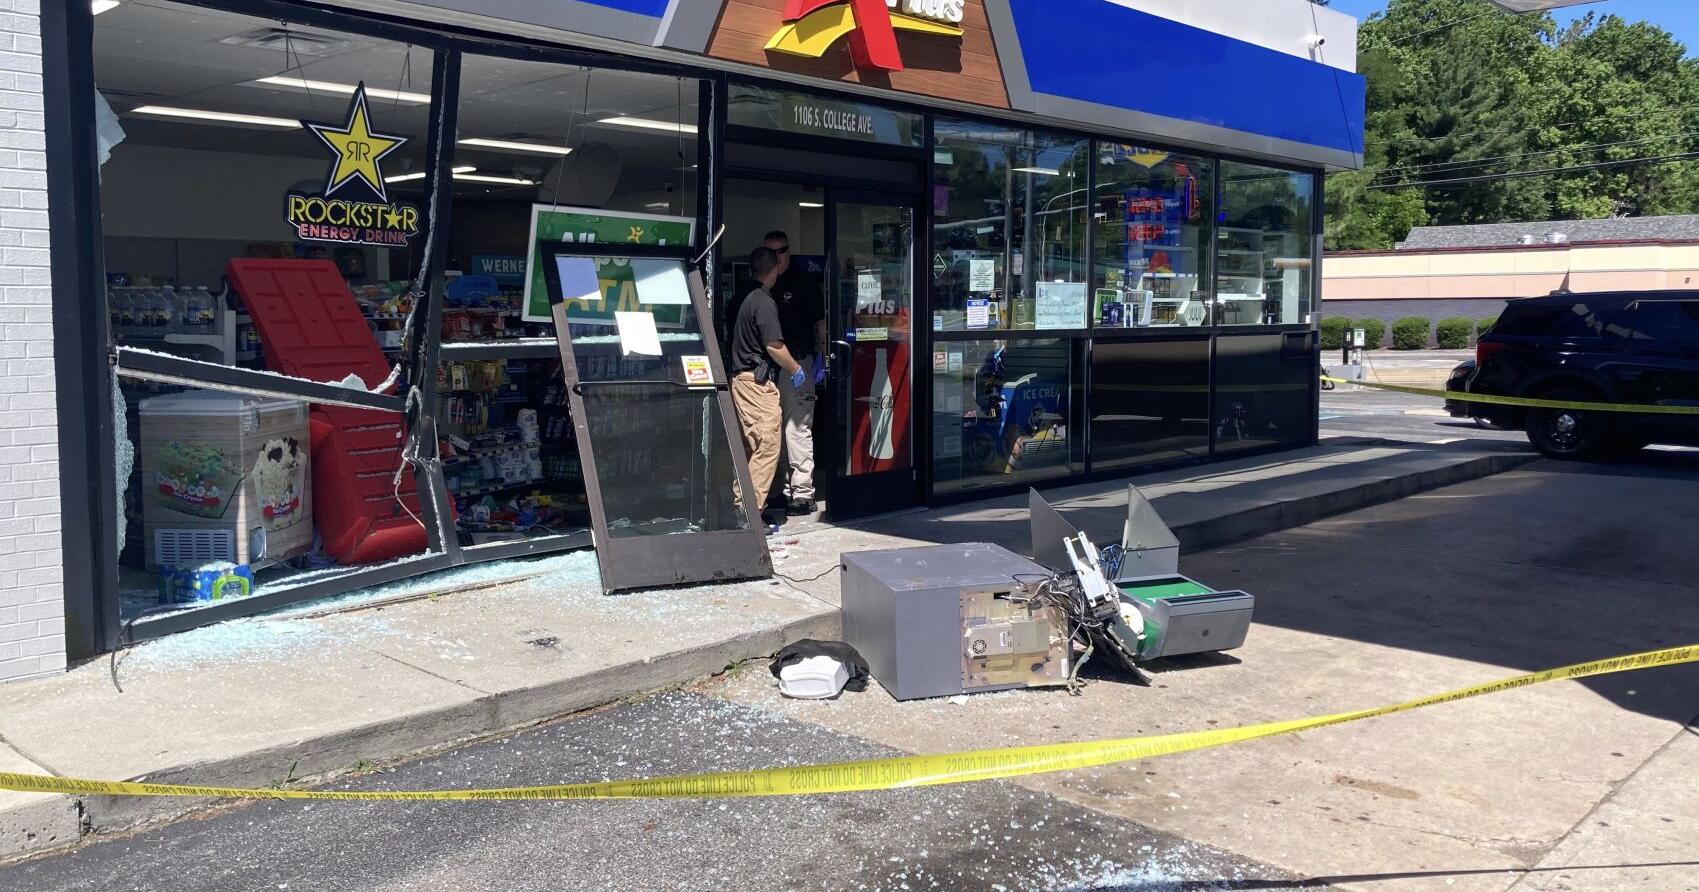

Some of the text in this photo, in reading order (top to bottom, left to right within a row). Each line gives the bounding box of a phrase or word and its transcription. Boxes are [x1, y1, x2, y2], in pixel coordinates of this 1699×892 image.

[794, 105, 874, 135] 1106 S. COLLEGE AVE.
[300, 223, 407, 243] ENERGY DRINK
[1023, 388, 1038, 400] ICE
